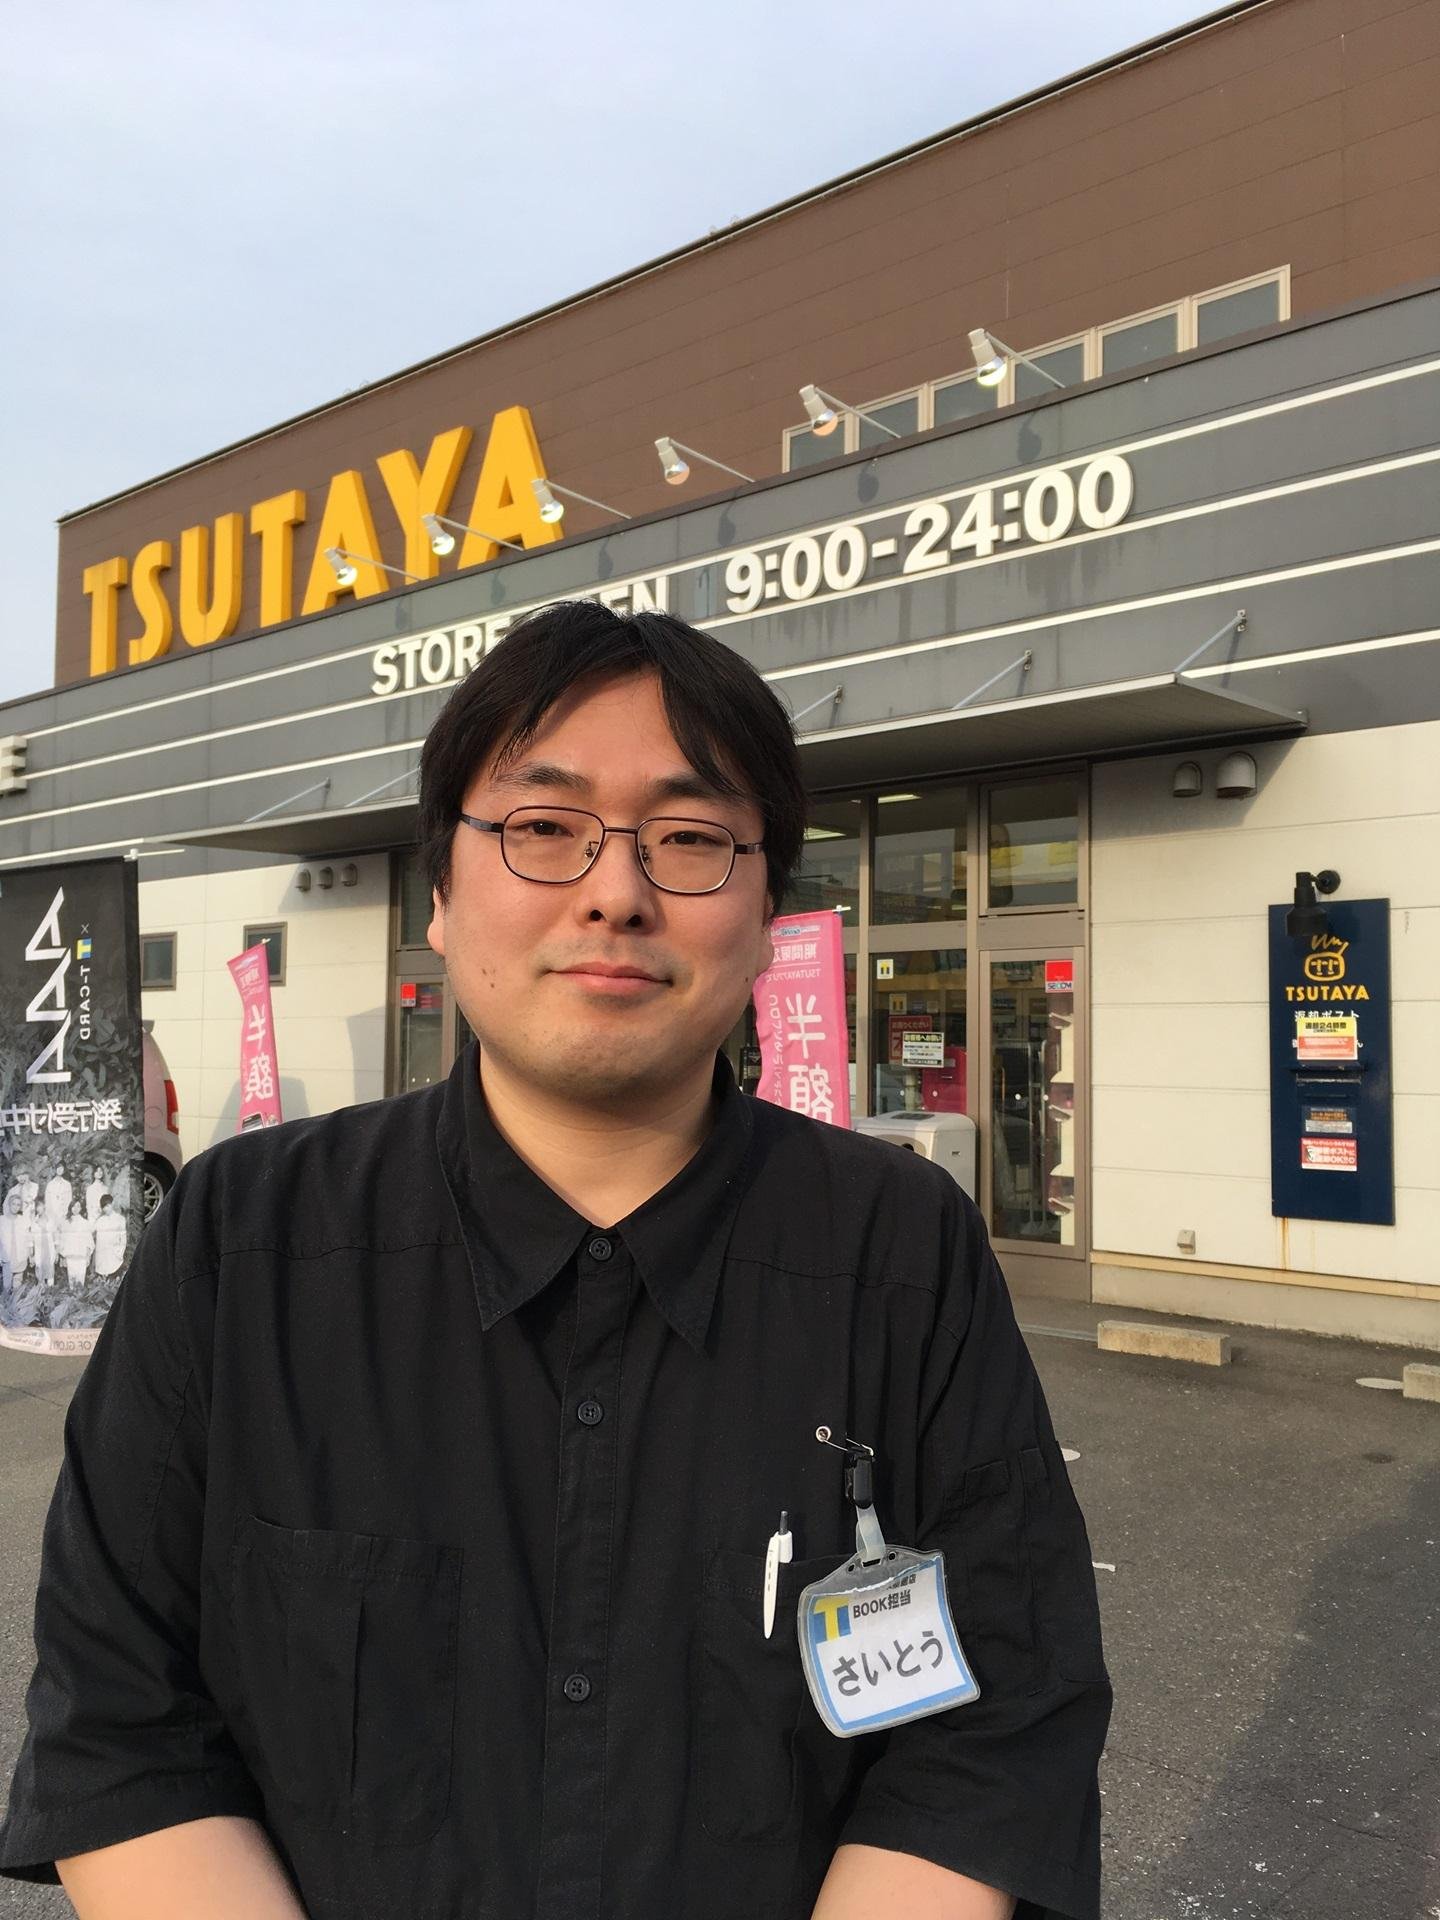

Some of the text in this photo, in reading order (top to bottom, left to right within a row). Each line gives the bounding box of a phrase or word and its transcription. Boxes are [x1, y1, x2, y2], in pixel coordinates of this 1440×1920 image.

[83, 404, 564, 677] TSUTAYA
[726, 454, 1135, 614] 9:00-24:00
[1285, 985, 1370, 1002] TSUTAYA
[852, 1589, 912, 1619] BOOK担当
[832, 1630, 944, 1697] さいとう
